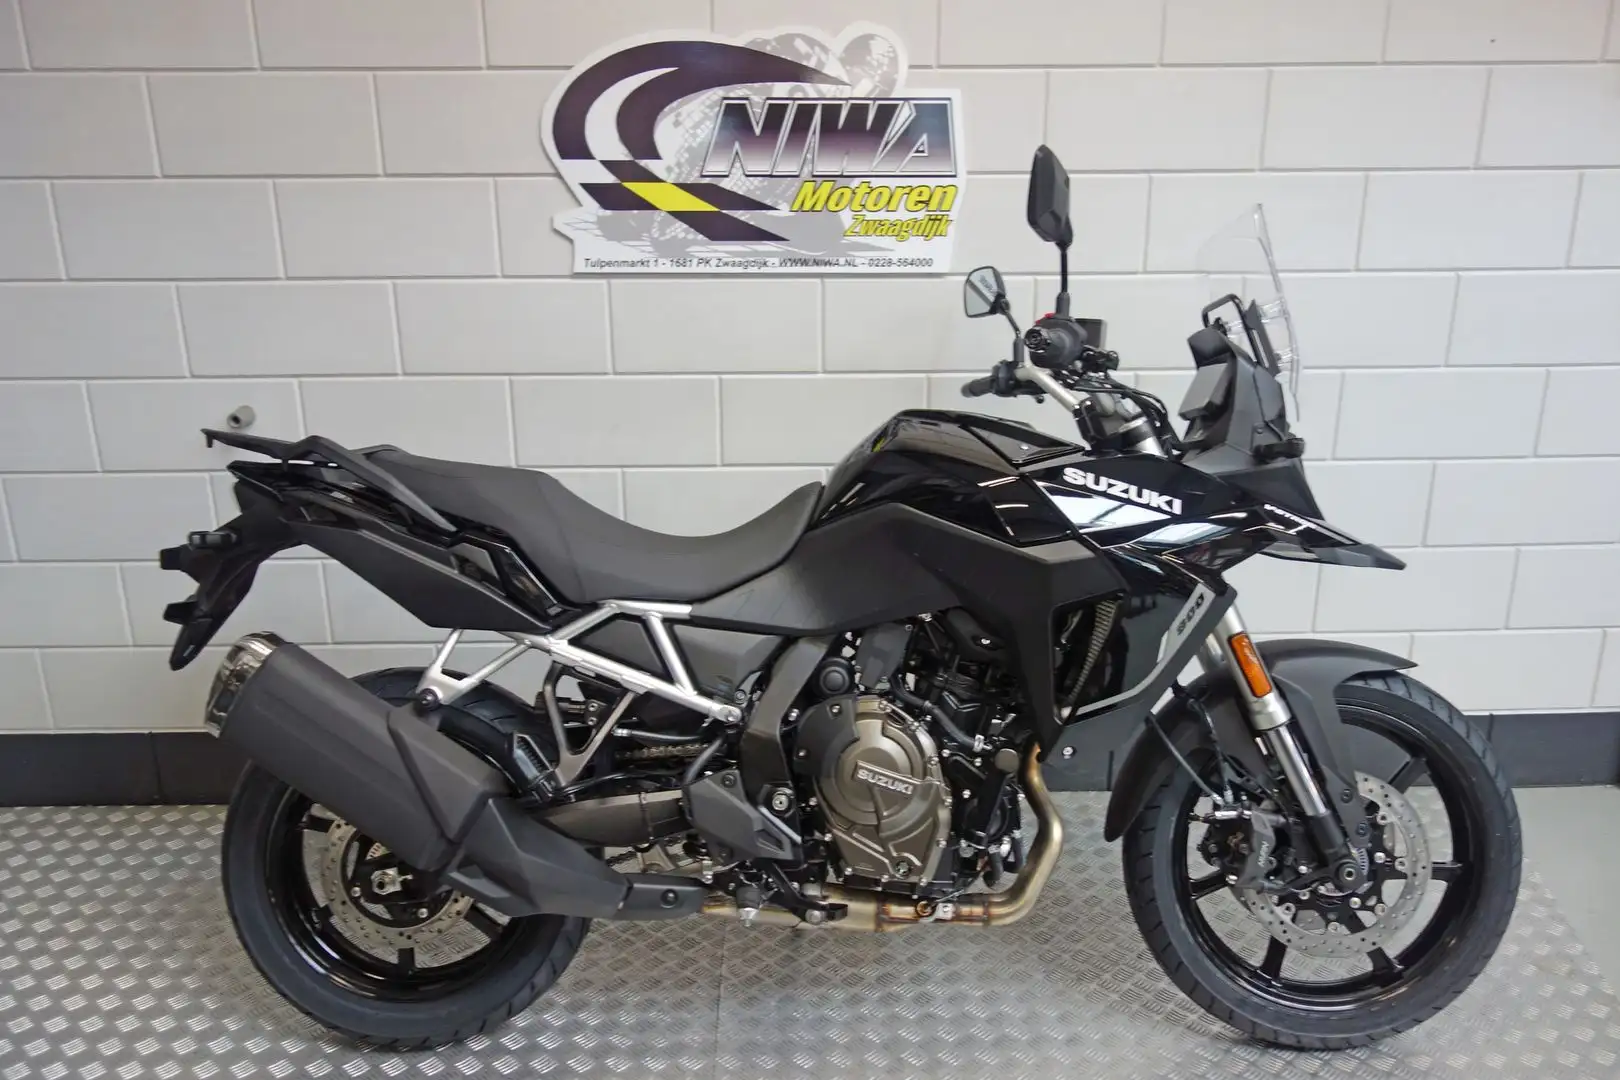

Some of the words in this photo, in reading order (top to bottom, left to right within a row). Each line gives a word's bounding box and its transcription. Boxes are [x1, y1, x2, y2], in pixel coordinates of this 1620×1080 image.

[701, 97, 957, 178] NIWA
[789, 180, 958, 213] Motoren
[843, 214, 952, 242] Zwaagdijk
[583, 257, 650, 269] Tulpenmarkt
[653, 258, 659, 268] 1
[696, 257, 712, 268] PK
[715, 258, 768, 270] Zwaagdijk
[778, 257, 859, 268] WWW.NIWA.NL
[1062, 467, 1183, 516] SUZUKI
[1176, 592, 1205, 637] 800
[856, 768, 914, 795] SUZUKI
